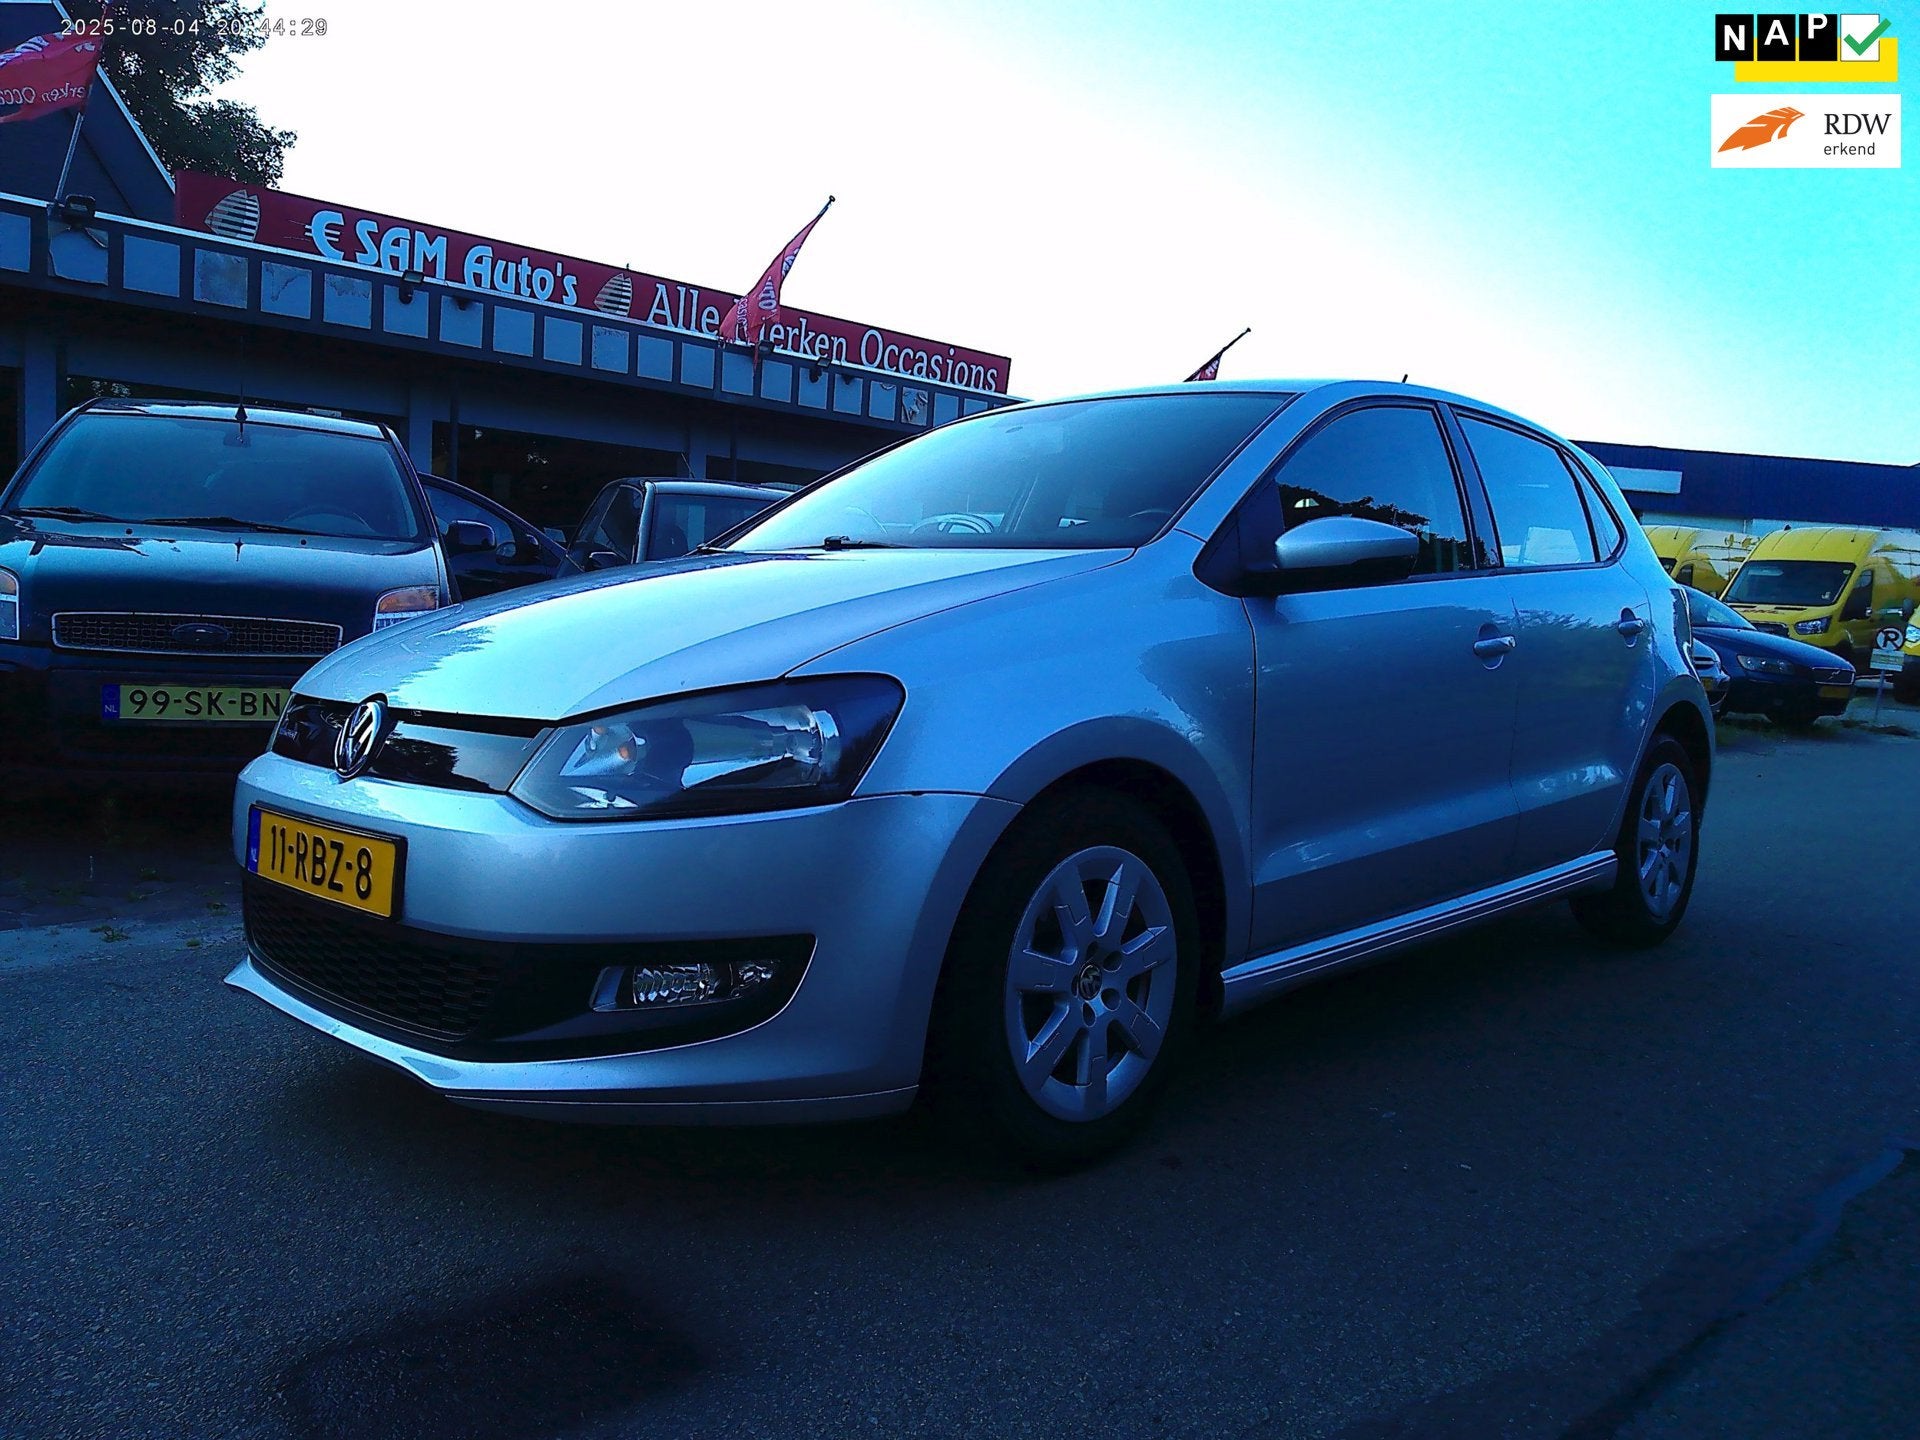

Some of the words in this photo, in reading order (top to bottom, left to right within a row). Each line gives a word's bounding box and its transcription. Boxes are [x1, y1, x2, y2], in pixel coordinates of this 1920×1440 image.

[463, 244, 578, 306] Auto's
[646, 282, 720, 337] Alle
[859, 328, 999, 393] Occasions
[104, 704, 117, 713] NL
[128, 689, 281, 717] 99-SK-BN
[270, 823, 373, 901] 11-RBZ-8
